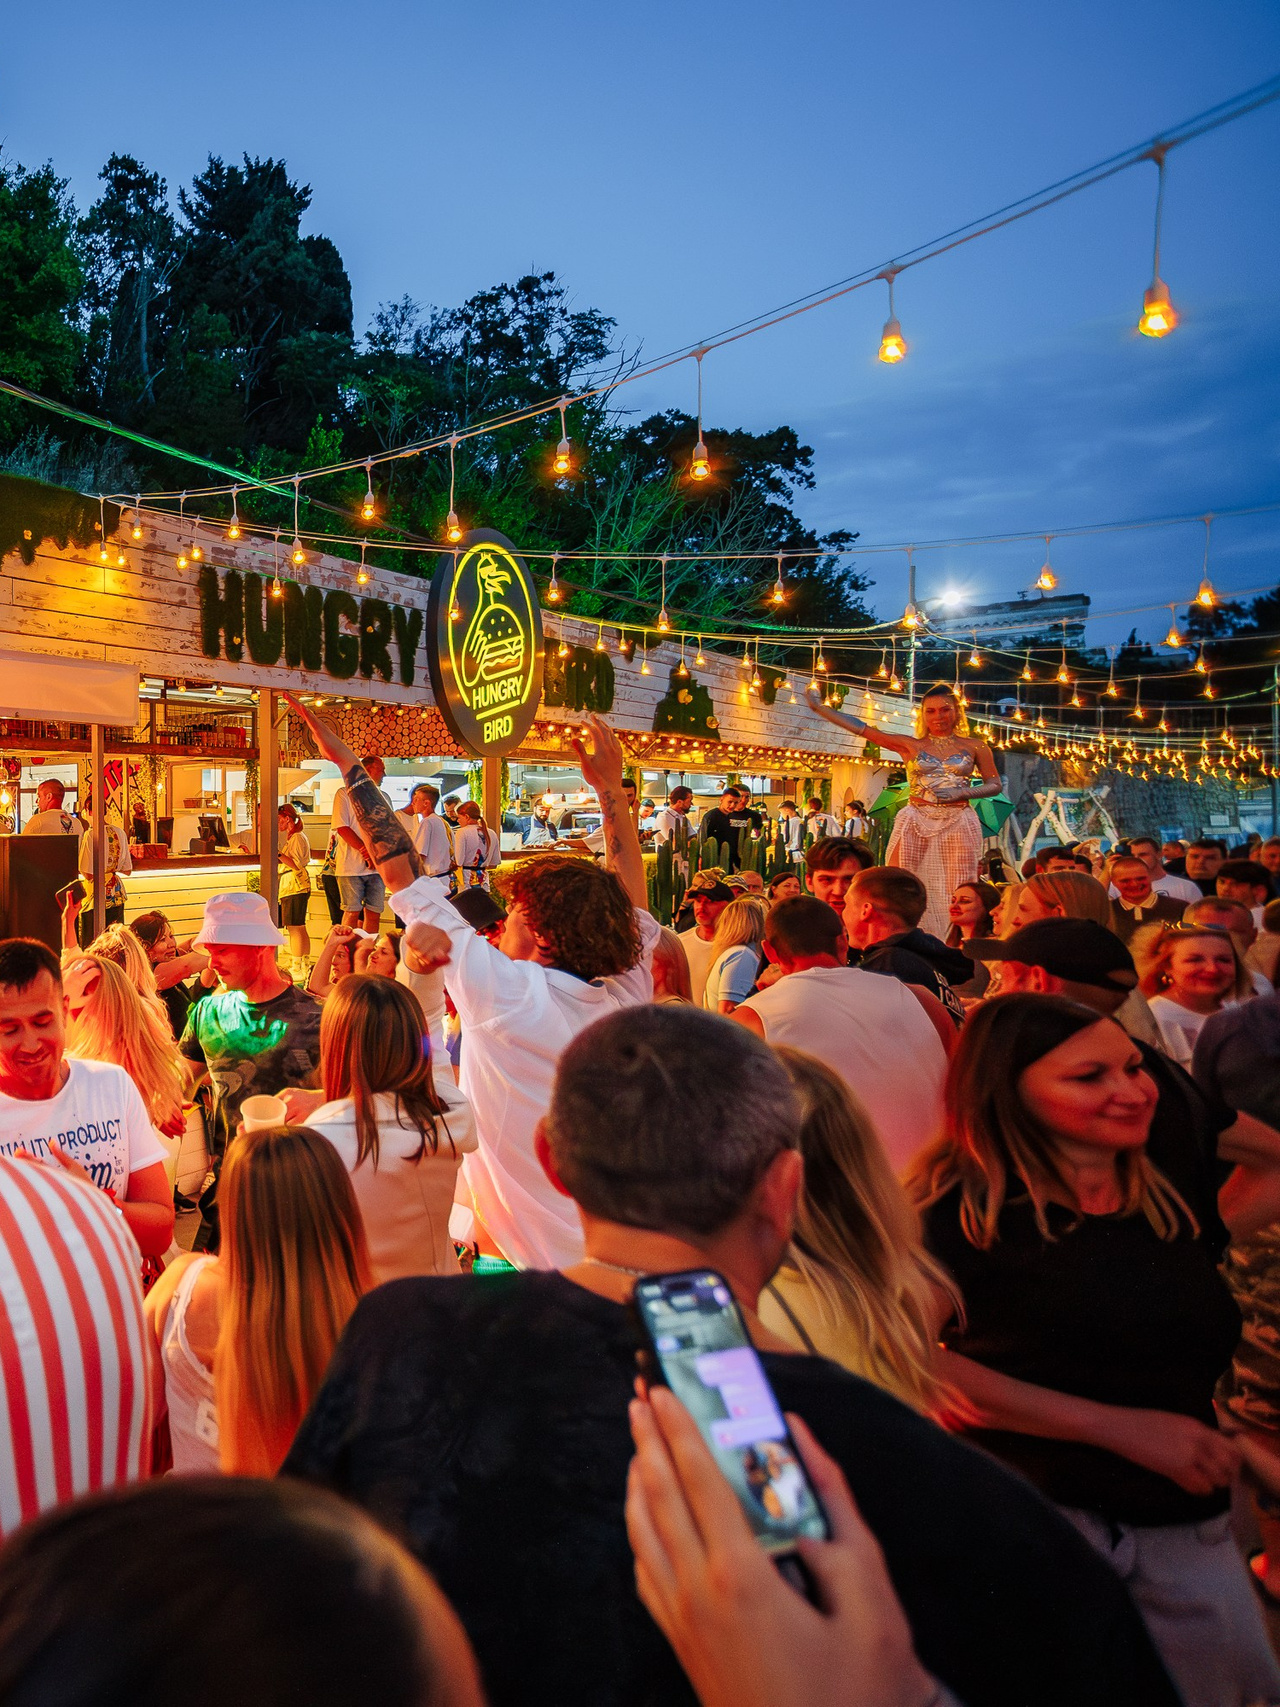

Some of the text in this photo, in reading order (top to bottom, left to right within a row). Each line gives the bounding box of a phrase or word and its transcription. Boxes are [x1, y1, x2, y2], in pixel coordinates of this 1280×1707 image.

[198, 564, 615, 713] HUNGRY BIRD
[472, 674, 524, 710] HUNGRY
[483, 714, 514, 744] BIRD
[57, 1119, 122, 1151] PRODUCT
